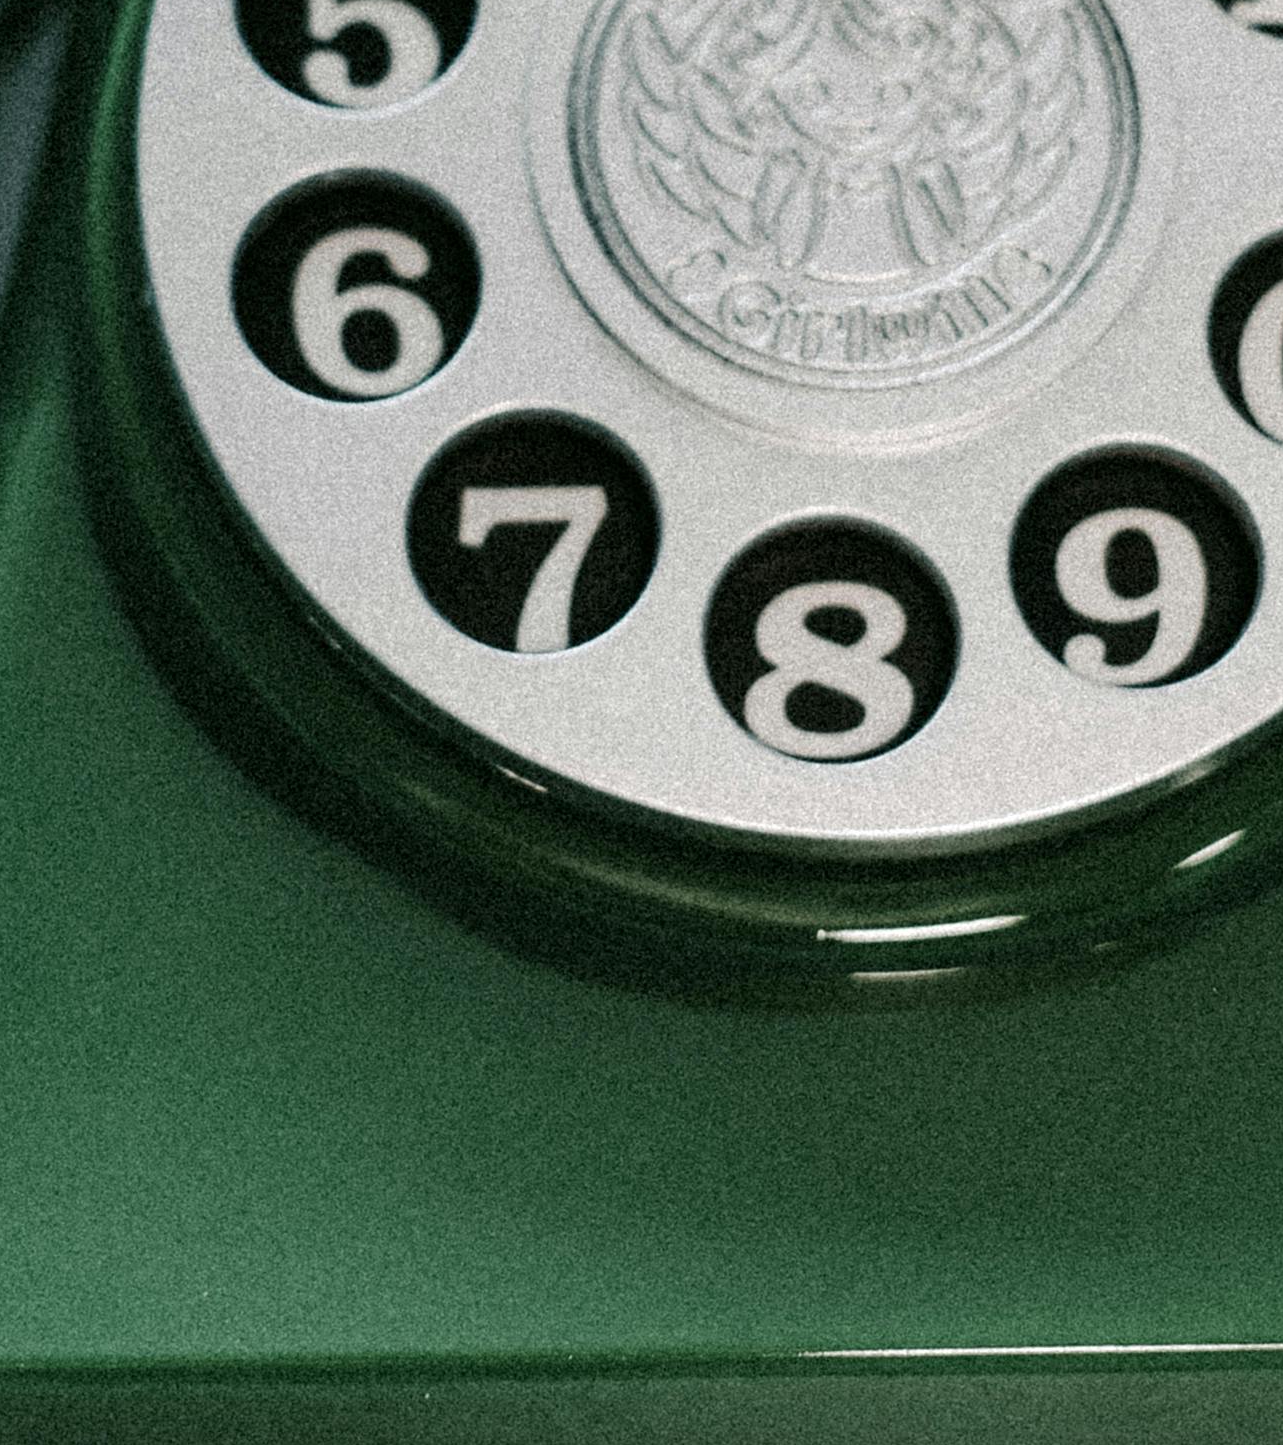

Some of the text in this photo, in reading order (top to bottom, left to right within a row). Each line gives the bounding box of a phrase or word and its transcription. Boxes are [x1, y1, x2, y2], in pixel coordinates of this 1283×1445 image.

[291, 227, 445, 398] 6
[457, 485, 608, 653] 7
[1054, 506, 1208, 685] 9
[743, 580, 915, 760] 8
